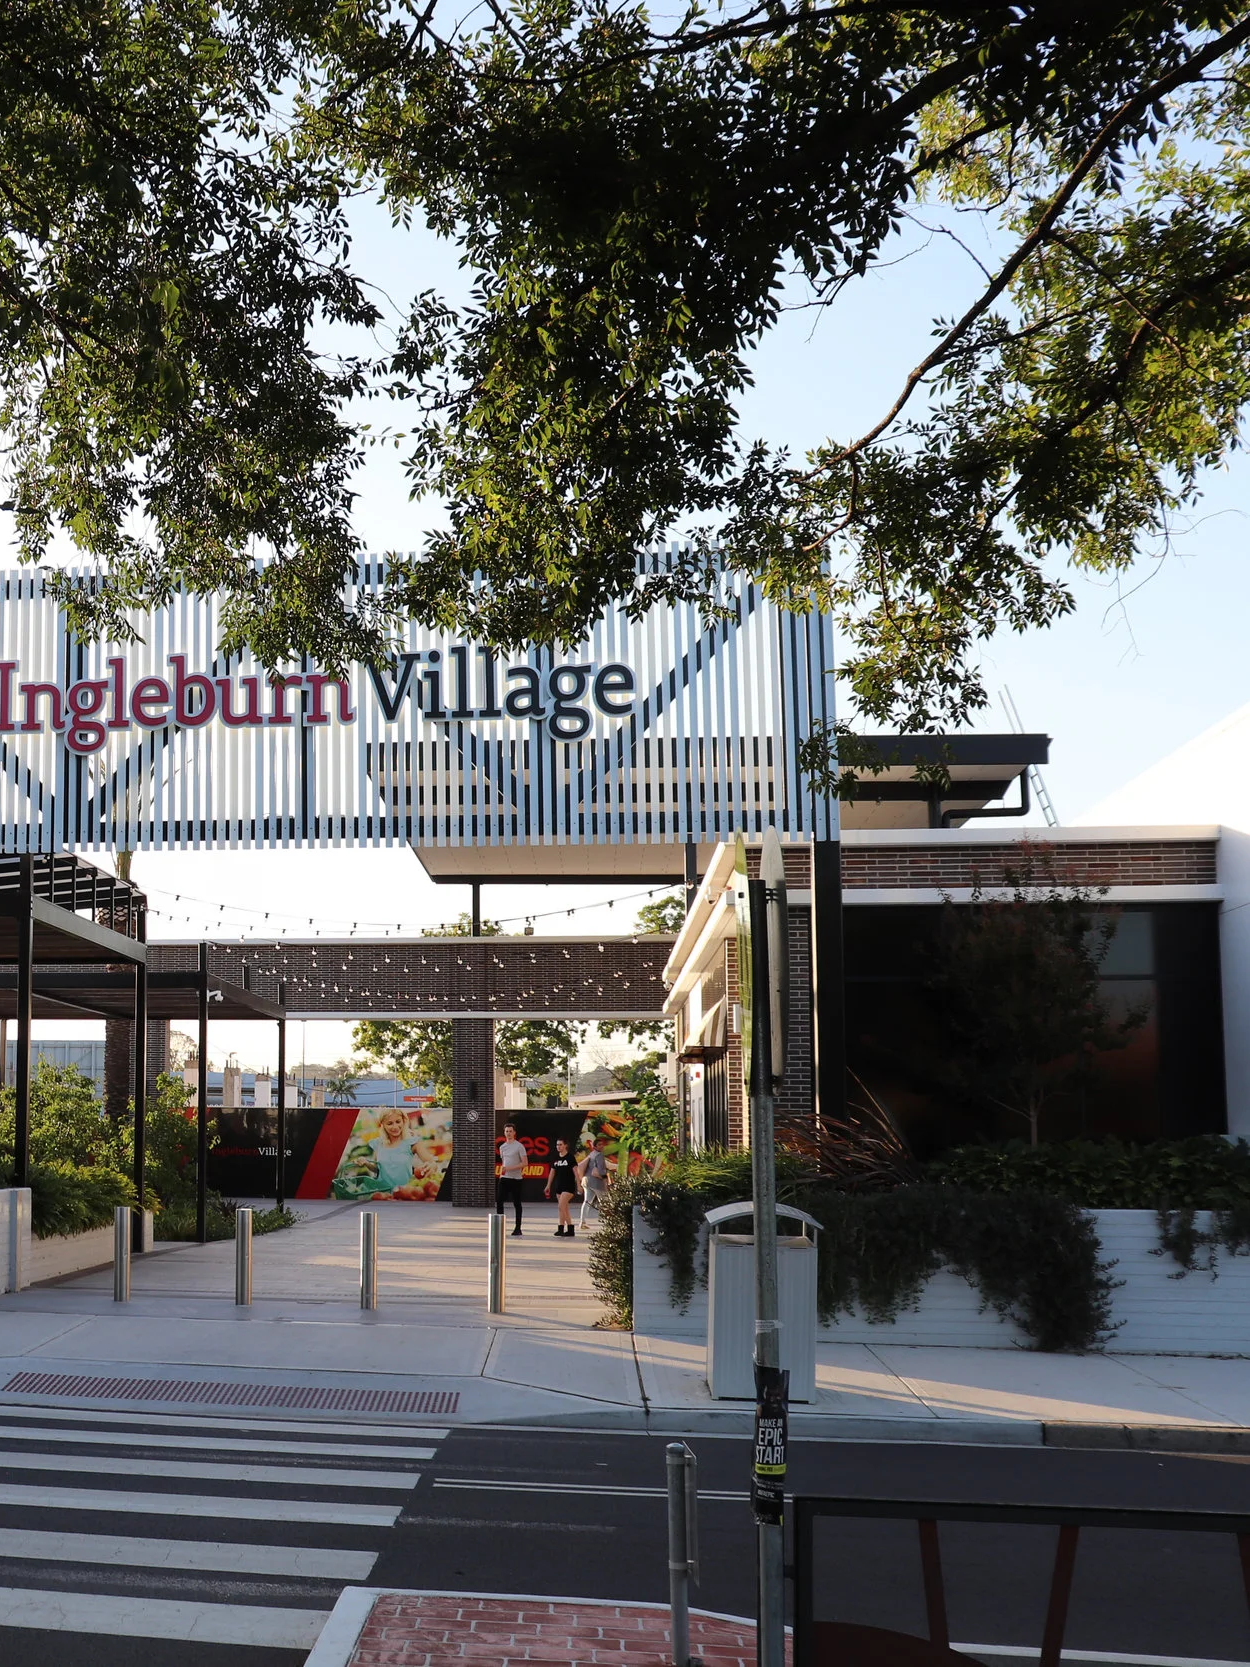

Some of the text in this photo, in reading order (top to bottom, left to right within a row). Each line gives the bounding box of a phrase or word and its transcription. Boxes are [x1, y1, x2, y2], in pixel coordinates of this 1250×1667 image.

[364, 645, 635, 740] Village
[759, 1418, 776, 1427] MAKE
[758, 1428, 783, 1446] EPIC
[755, 1445, 785, 1464] START
